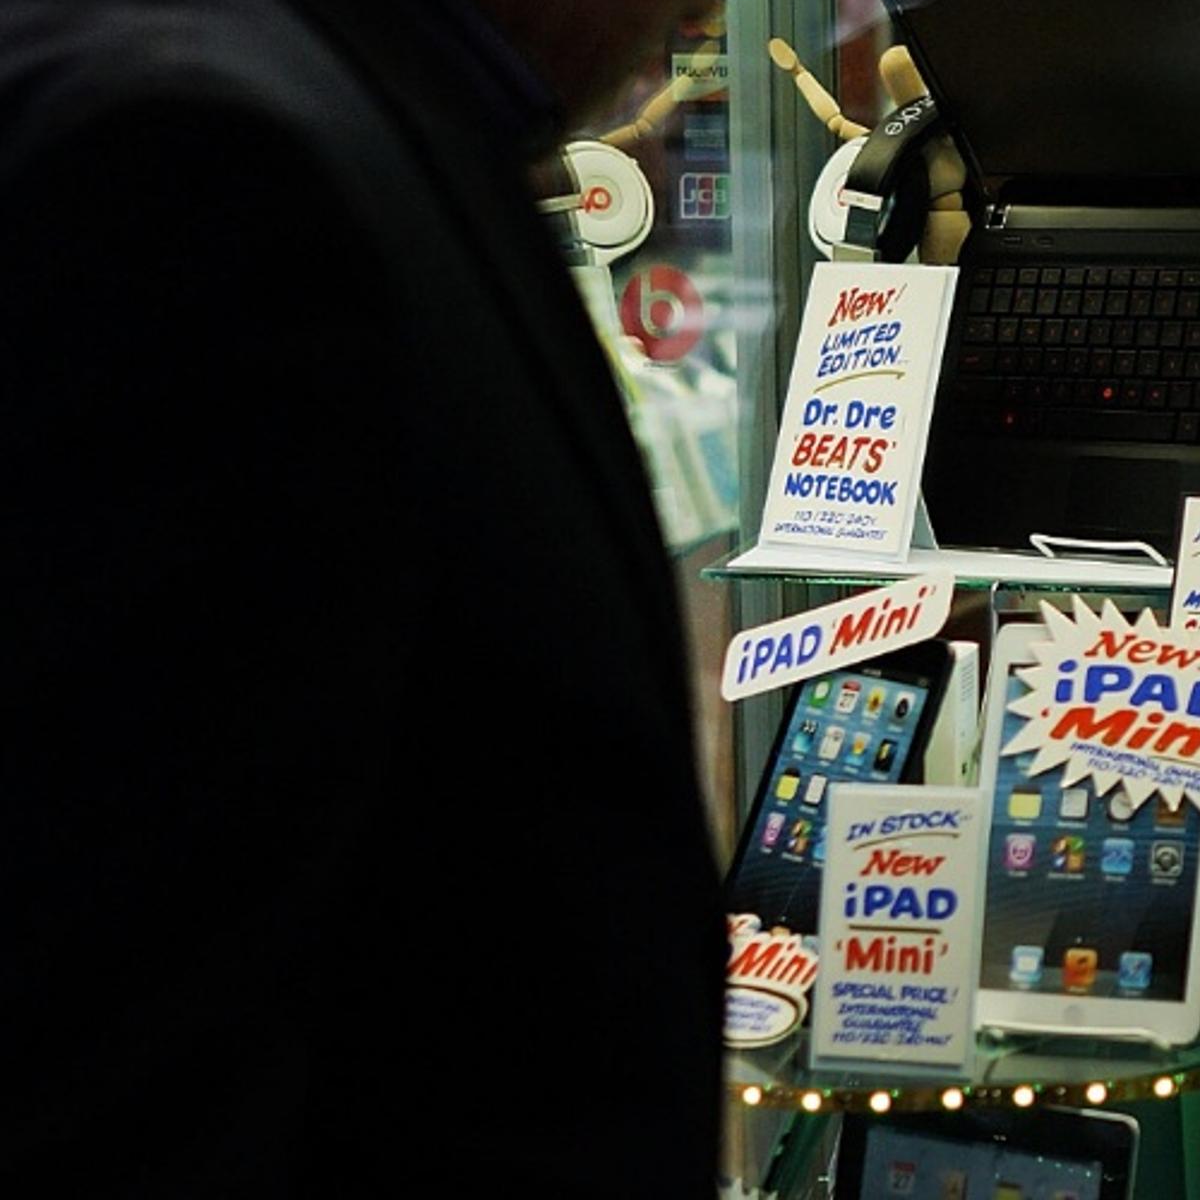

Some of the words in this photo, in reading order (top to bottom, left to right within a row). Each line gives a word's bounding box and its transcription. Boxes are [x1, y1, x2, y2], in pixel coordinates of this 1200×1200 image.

[820, 321, 902, 356] LIMITED
[844, 399, 897, 429] Dre
[784, 472, 899, 506] NOTEBOOK
[737, 623, 823, 684] iPAD
[846, 822, 875, 842] IN
[859, 849, 947, 877] New
[844, 882, 958, 921] iPAD
